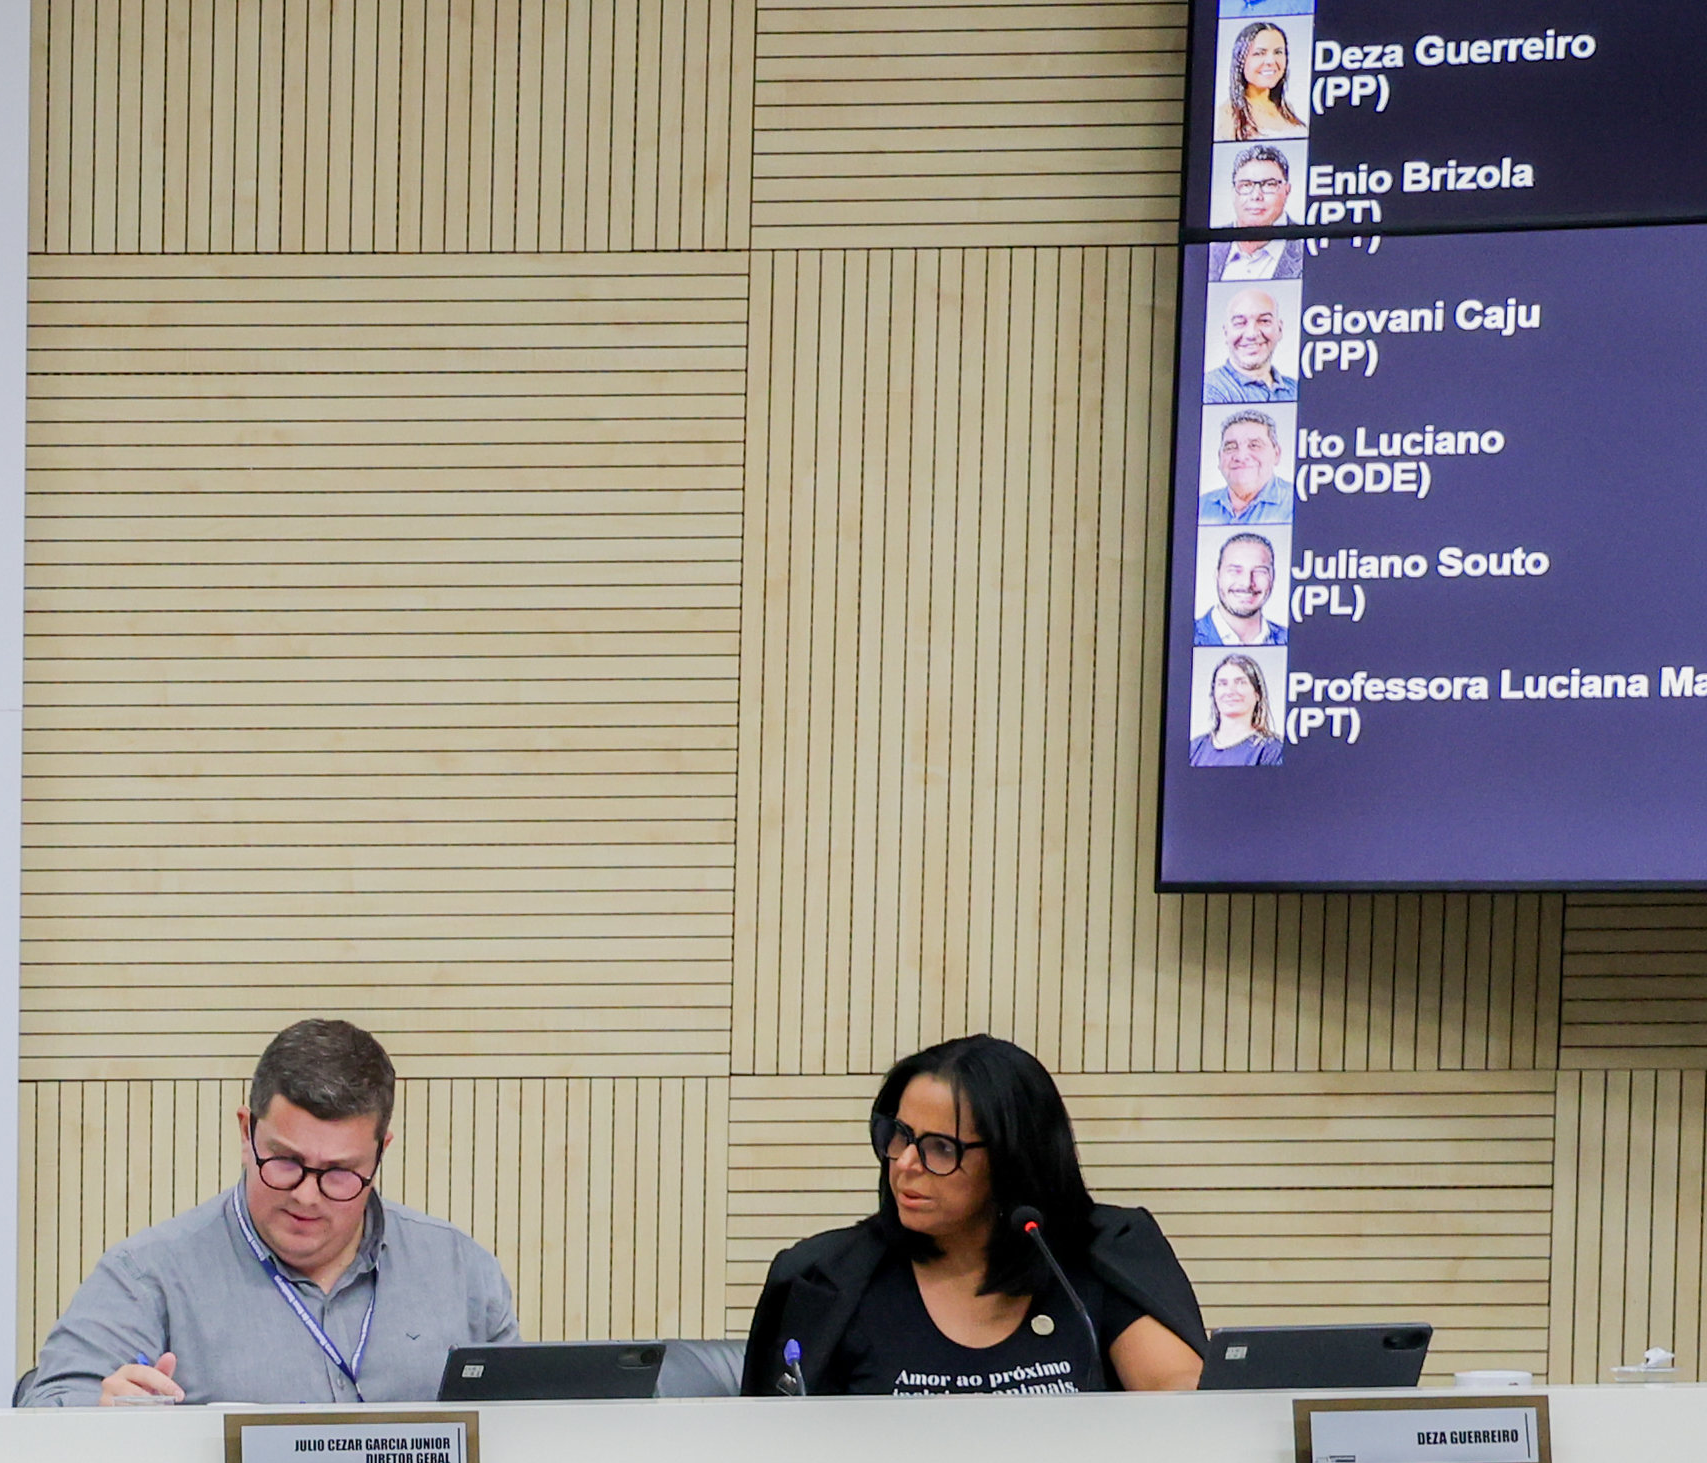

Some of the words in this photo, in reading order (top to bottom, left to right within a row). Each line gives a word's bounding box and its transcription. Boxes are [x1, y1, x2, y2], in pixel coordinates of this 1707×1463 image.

[1314, 38, 1404, 72] Deza
[1415, 29, 1597, 67] Guerreiro
[1312, 75, 1391, 114] (PP)
[1307, 162, 1393, 197] Enio
[1402, 157, 1535, 192] Brizola
[1301, 301, 1445, 336] Giovani
[1454, 298, 1541, 337] Caju
[1300, 340, 1379, 378] (PP)
[1296, 427, 1344, 461] Ito
[1355, 424, 1505, 456] Luciano
[1295, 461, 1431, 501] (PODE)
[1291, 549, 1428, 580] Juliano
[1437, 545, 1550, 578] Souto
[1290, 584, 1366, 622] (PL)
[1288, 671, 1489, 704] Professora
[1499, 668, 1649, 700] Luciana
[1286, 706, 1361, 744] (PT)
[895, 1369, 951, 1387] Amor
[956, 1374, 983, 1387] ao
[989, 1360, 1071, 1388] próximo
[295, 1439, 325, 1452] JULIO
[328, 1438, 363, 1451] CEZAR
[365, 1438, 408, 1450] GARCIA
[410, 1437, 451, 1450] JUNIOR
[1417, 1431, 1447, 1446] DEZA
[1450, 1428, 1519, 1445] GUERREIRO
